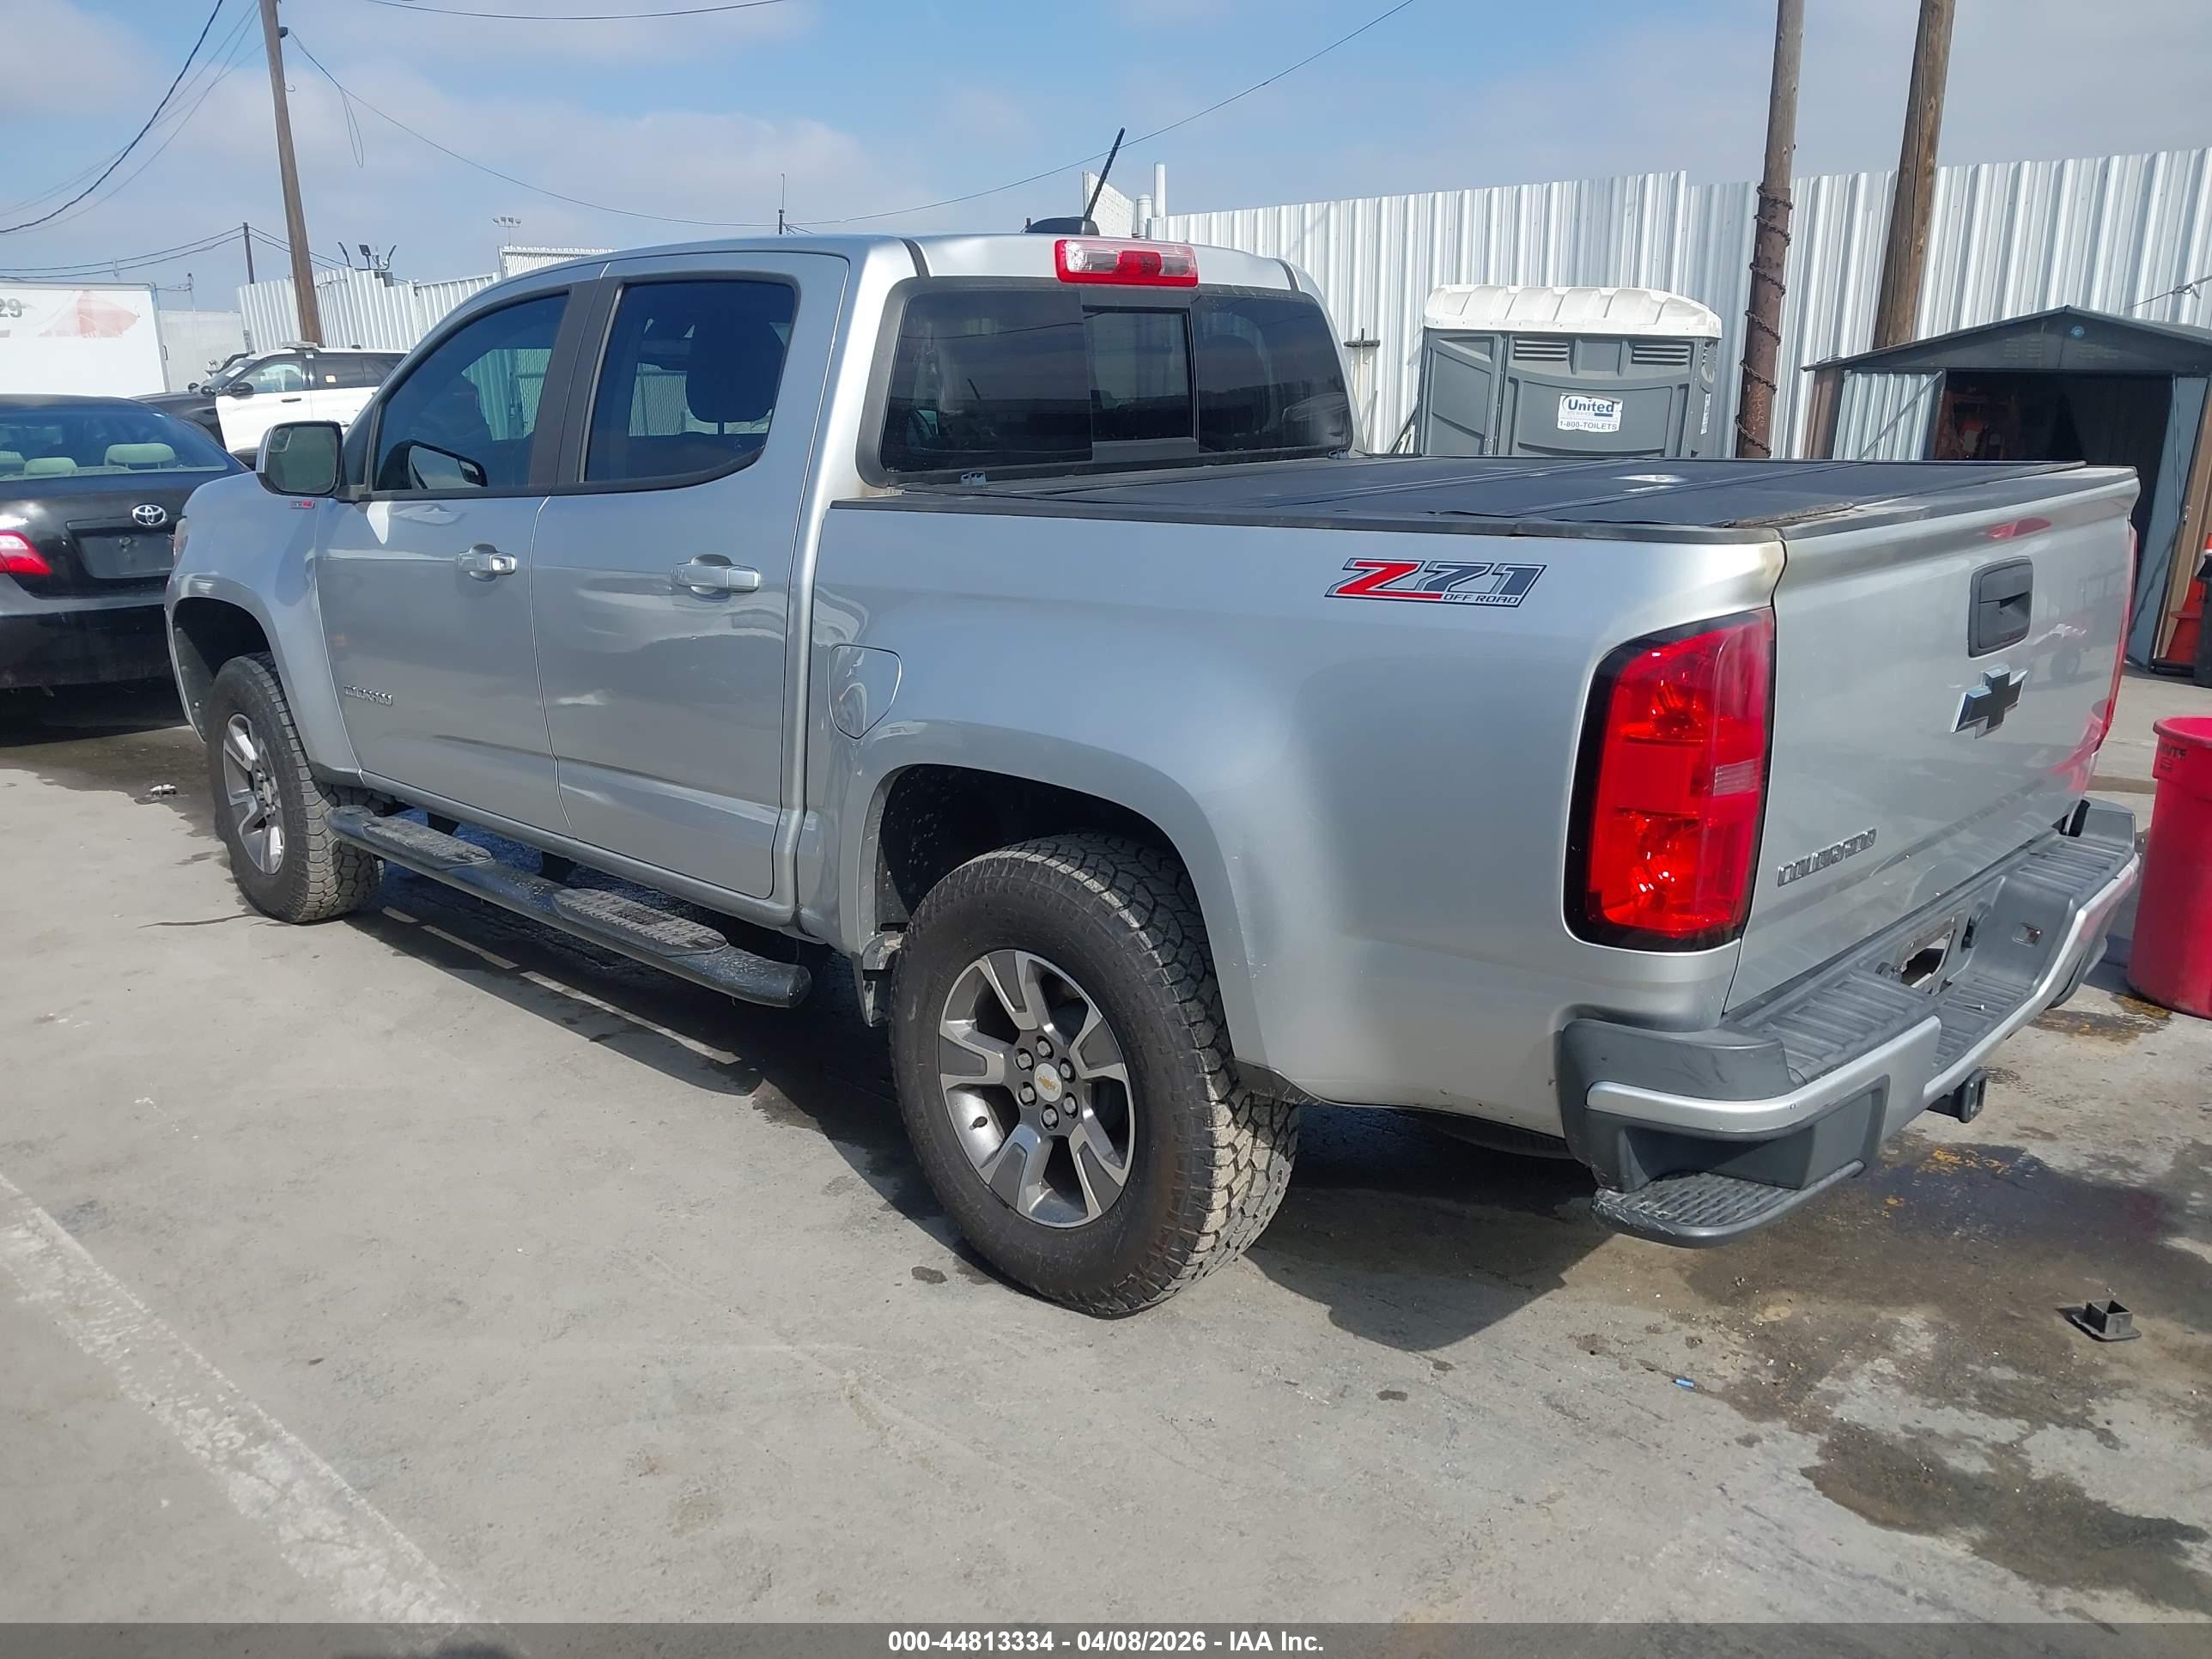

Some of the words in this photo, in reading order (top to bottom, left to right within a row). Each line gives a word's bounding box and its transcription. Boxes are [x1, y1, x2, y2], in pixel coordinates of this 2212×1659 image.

[1568, 398, 1615, 412] United
[1559, 420, 1618, 430] 1-800-TOILETS
[1325, 557, 1547, 607] Z71
[1443, 593, 1472, 602] OFF
[1475, 595, 1519, 604] ROAD
